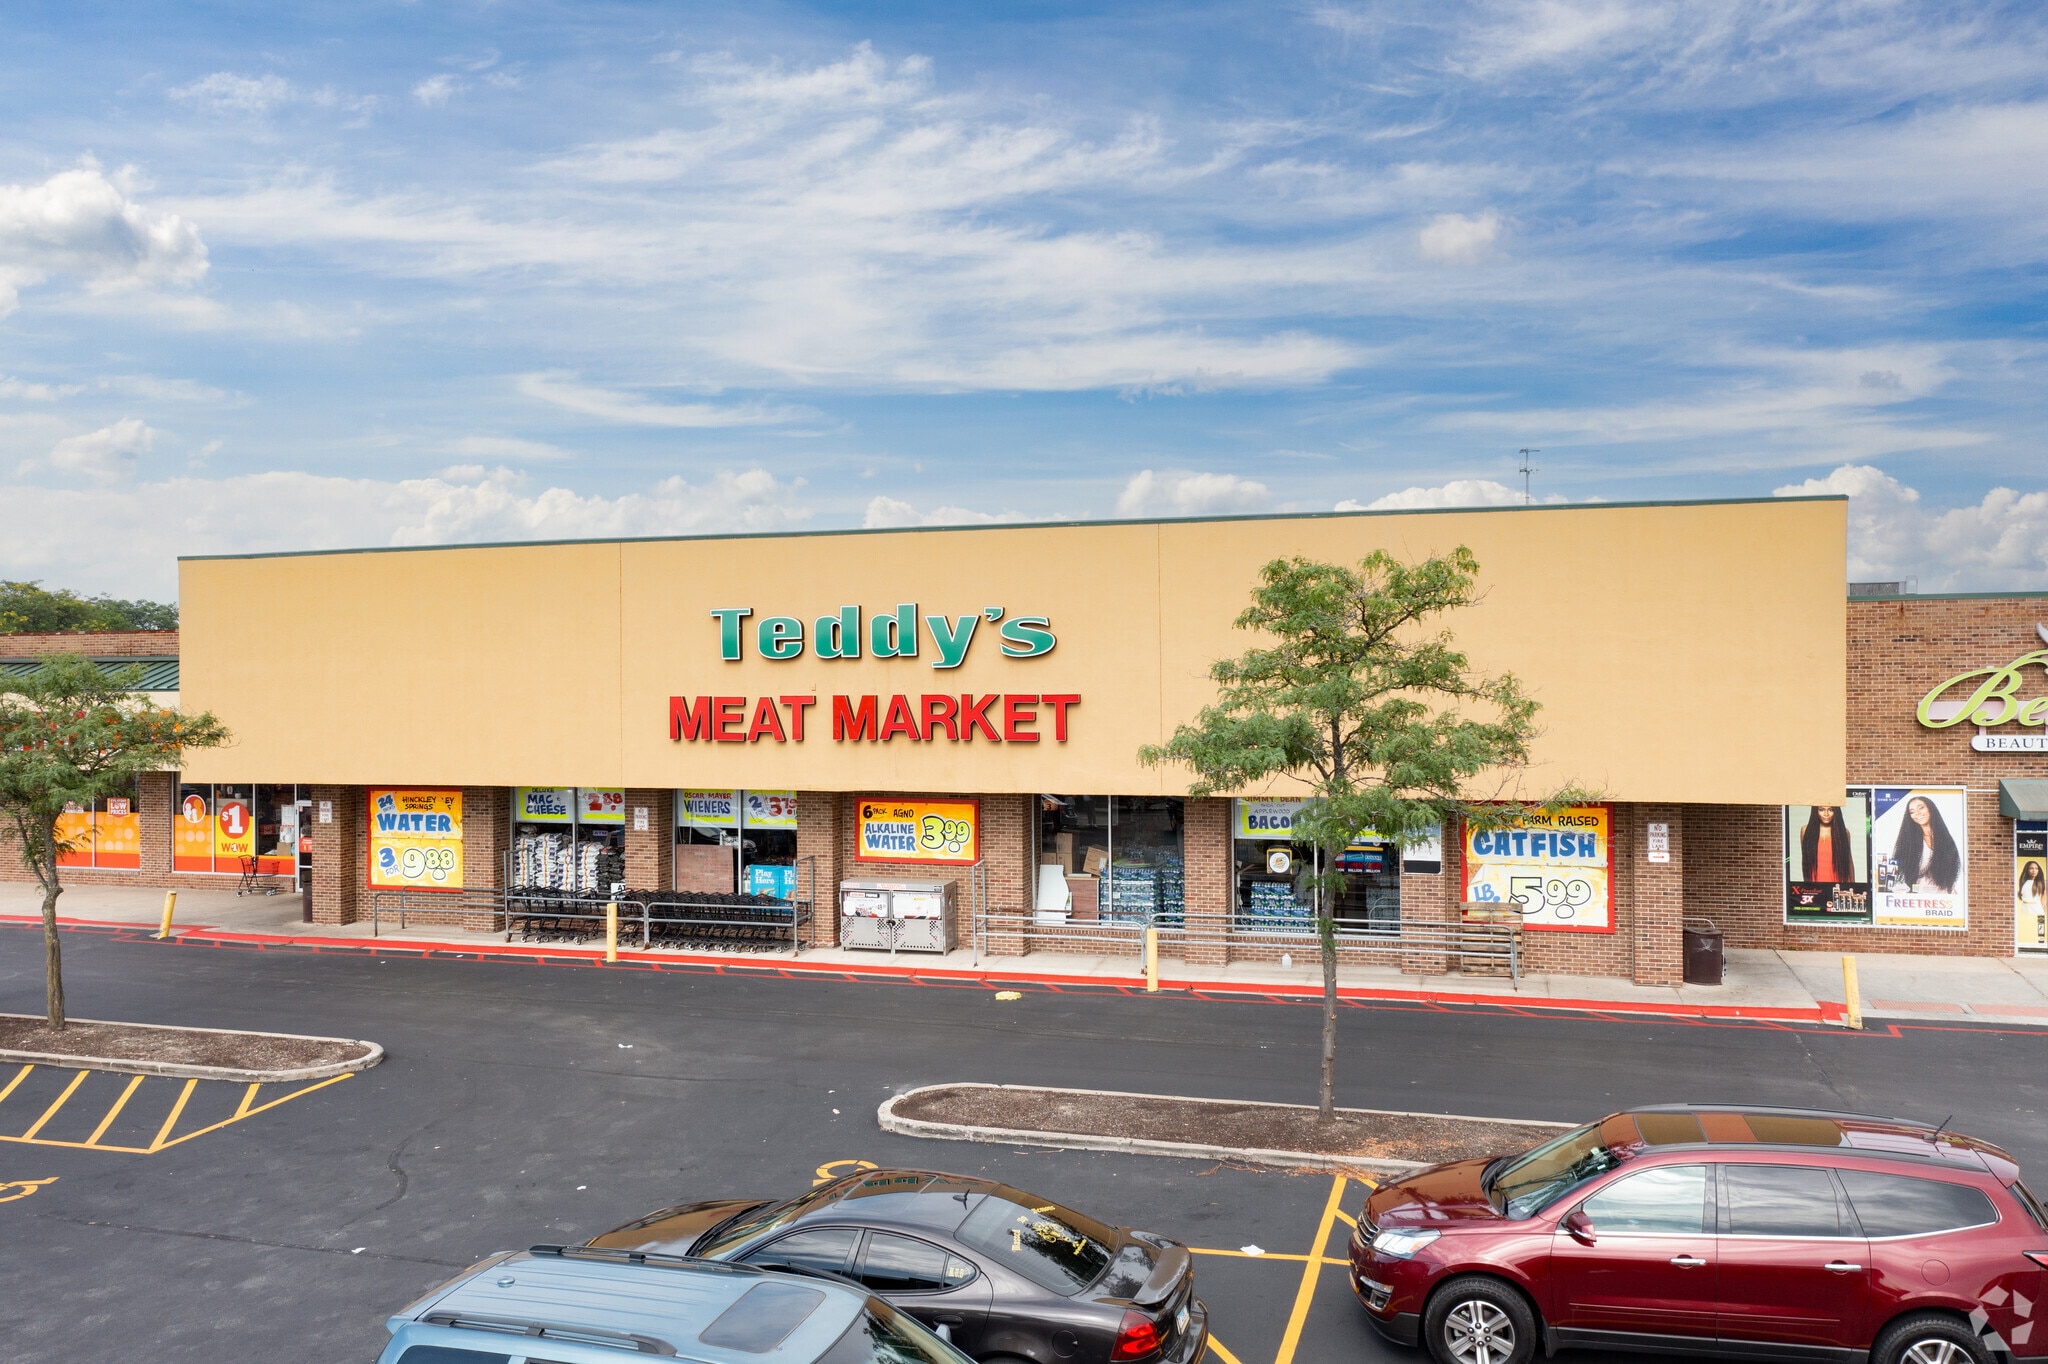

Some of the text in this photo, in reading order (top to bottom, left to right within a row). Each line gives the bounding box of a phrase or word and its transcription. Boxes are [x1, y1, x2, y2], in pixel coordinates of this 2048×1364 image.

[710, 603, 1056, 668] Teddy's
[1917, 649, 2048, 729] Be
[669, 693, 1080, 741] MEAT MARKET
[378, 795, 393, 808] 24
[528, 794, 553, 804] MAC
[526, 805, 567, 815] CHEESE
[684, 800, 731, 814] WIENERS
[863, 805, 873, 819] 6
[222, 805, 244, 834] $1
[376, 813, 451, 832] WATER
[1248, 815, 1301, 830] BACO
[1558, 816, 1599, 826] RAISED
[865, 823, 914, 834] ALKALINE
[866, 834, 916, 851] WATER
[1473, 831, 1596, 858] CATFISH
[379, 848, 395, 868] 3
[755, 869, 773, 879] Play
[1800, 895, 1815, 905] 3X
[1886, 895, 1953, 909] FREETRESS
[1925, 909, 1953, 917] BRAID
